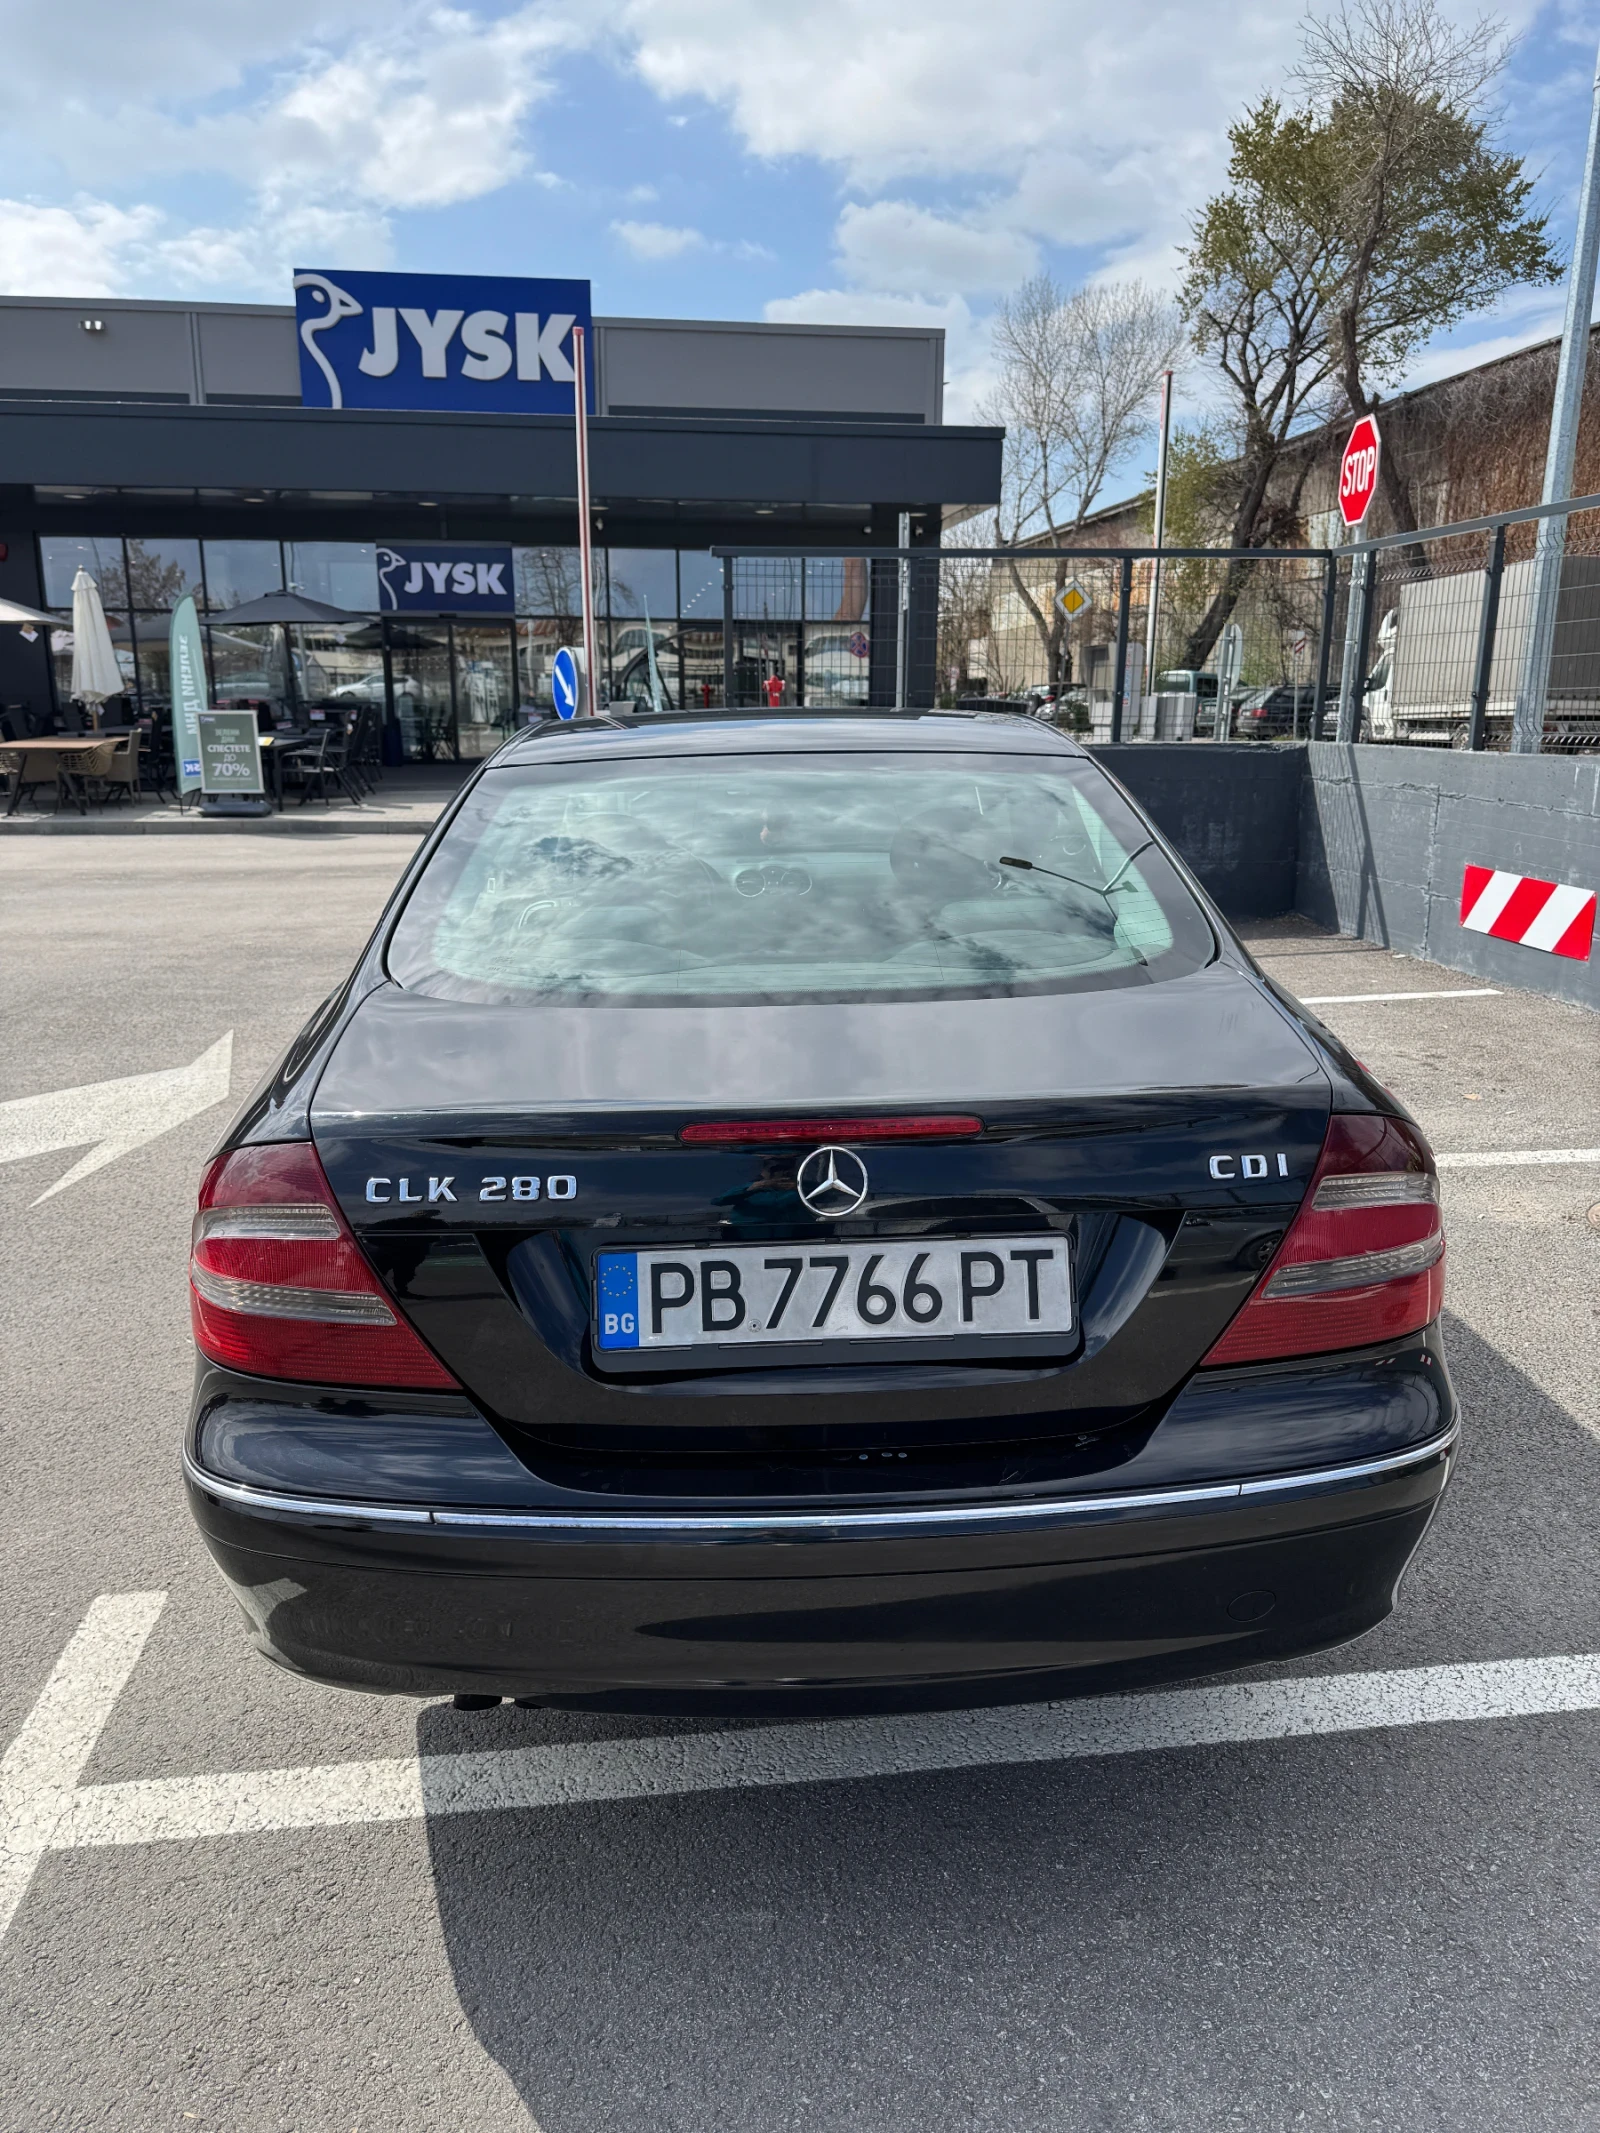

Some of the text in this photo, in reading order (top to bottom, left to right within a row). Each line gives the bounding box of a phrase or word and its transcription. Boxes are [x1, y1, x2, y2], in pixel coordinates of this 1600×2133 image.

[358, 306, 577, 382] JYSK
[1342, 445, 1376, 497] STOP
[404, 562, 508, 596] JYSK
[207, 744, 251, 753] СПЕСТЕТЕ
[223, 753, 237, 763] ДО
[212, 763, 250, 777] 70%
[1209, 1152, 1289, 1180] CDI
[365, 1174, 578, 1204] CLK 280
[604, 1313, 635, 1336] BG
